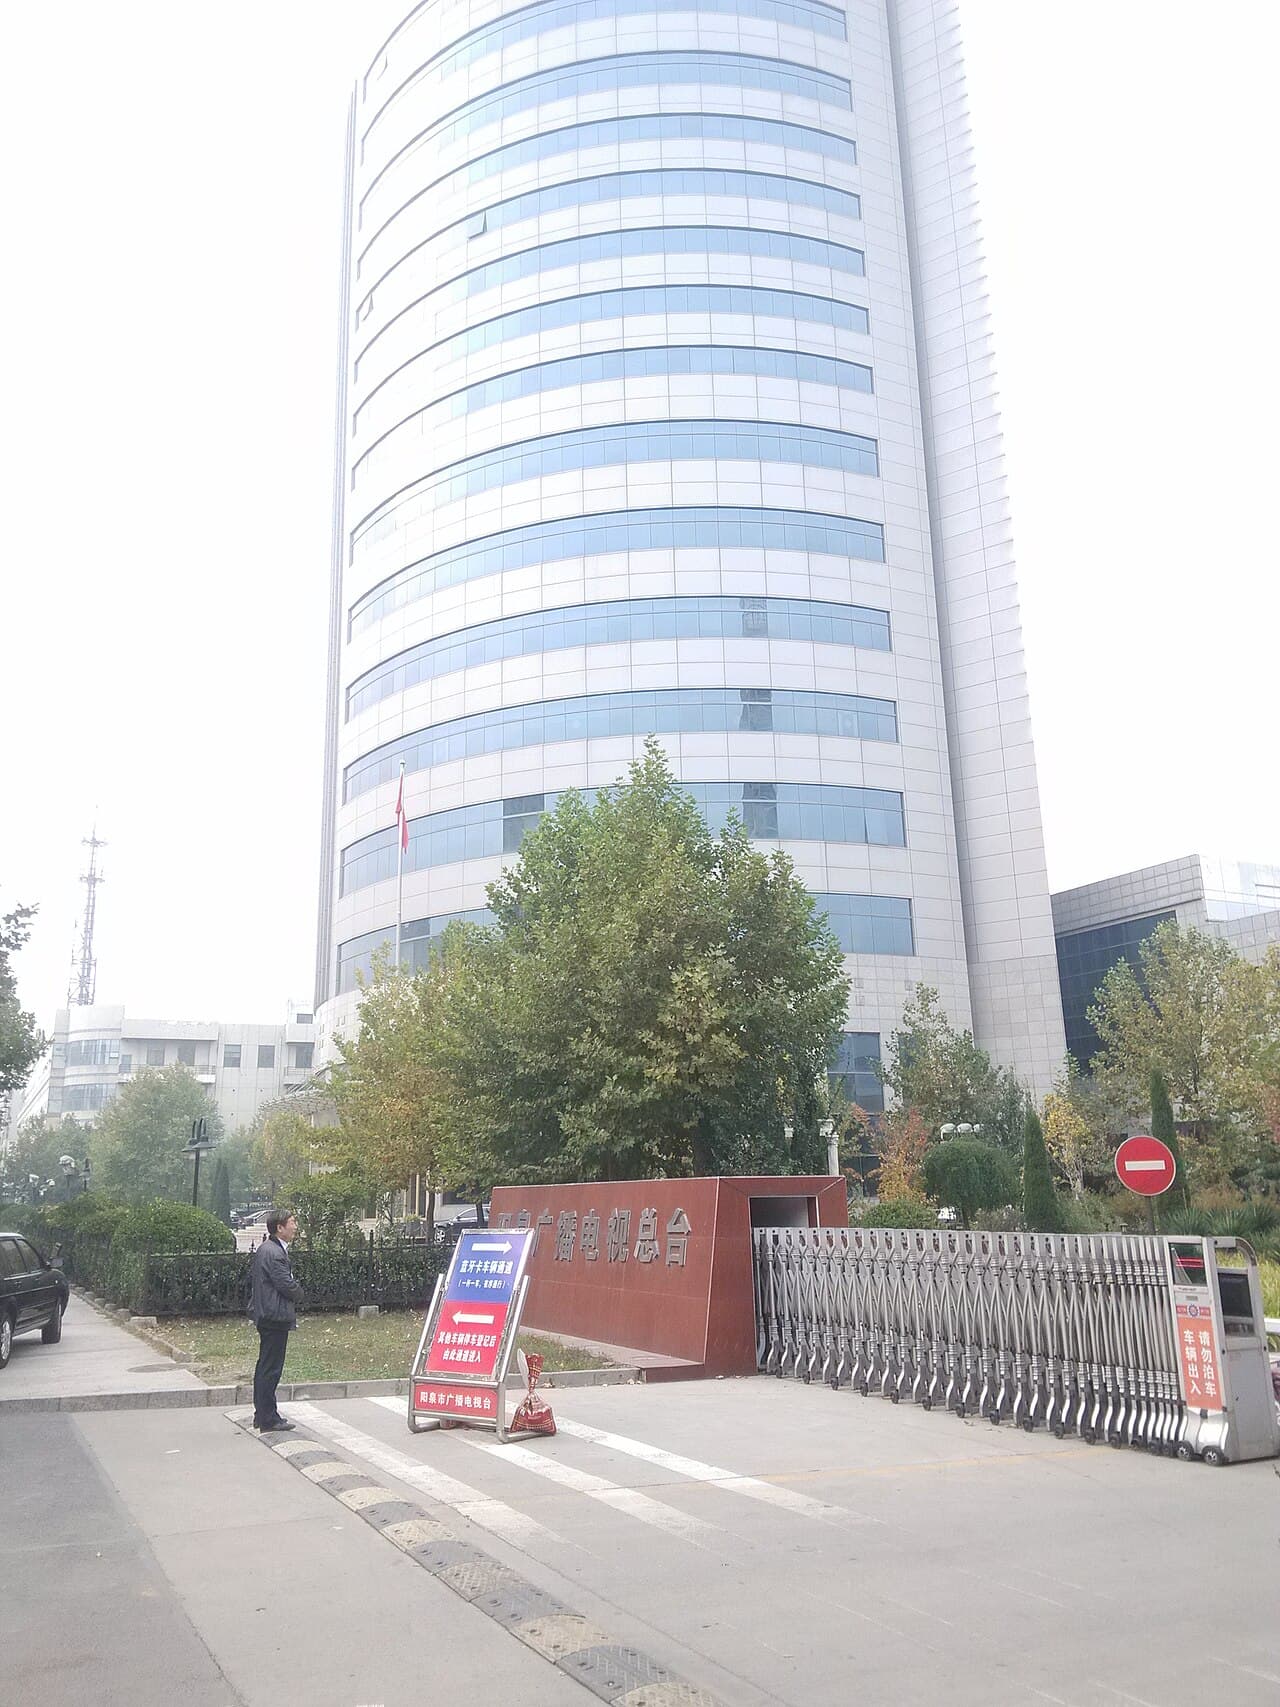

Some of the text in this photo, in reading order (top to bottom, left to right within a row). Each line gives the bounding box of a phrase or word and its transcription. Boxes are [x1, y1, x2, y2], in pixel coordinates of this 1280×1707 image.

[437, 1330, 496, 1347] 其他车辆停车登记后
[443, 1348, 481, 1363] 由此通道进入
[1183, 1329, 1202, 1395] 车辆出入
[1198, 1330, 1217, 1397] 请勿泊车
[420, 1391, 491, 1410] 阳泉市广播电视台
